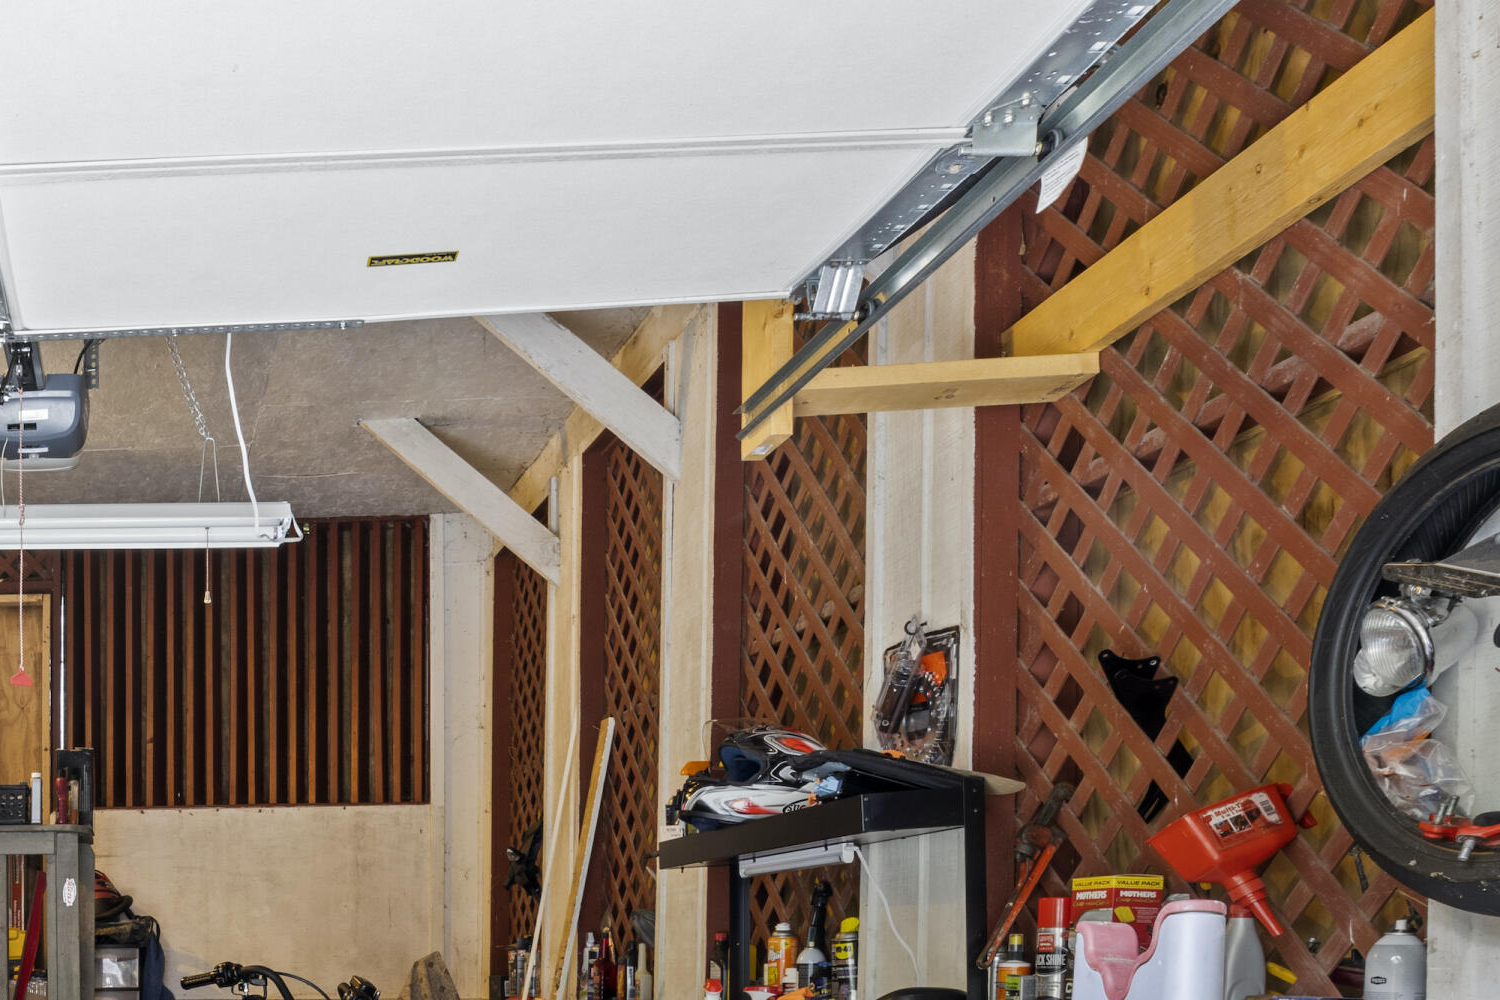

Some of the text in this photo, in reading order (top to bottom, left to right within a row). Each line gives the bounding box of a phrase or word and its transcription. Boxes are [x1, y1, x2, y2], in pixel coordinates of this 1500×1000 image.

[1075, 890, 1108, 901] MOTHERS
[1119, 890, 1157, 899] MOTHERS
[1046, 953, 1067, 967] SHINE
